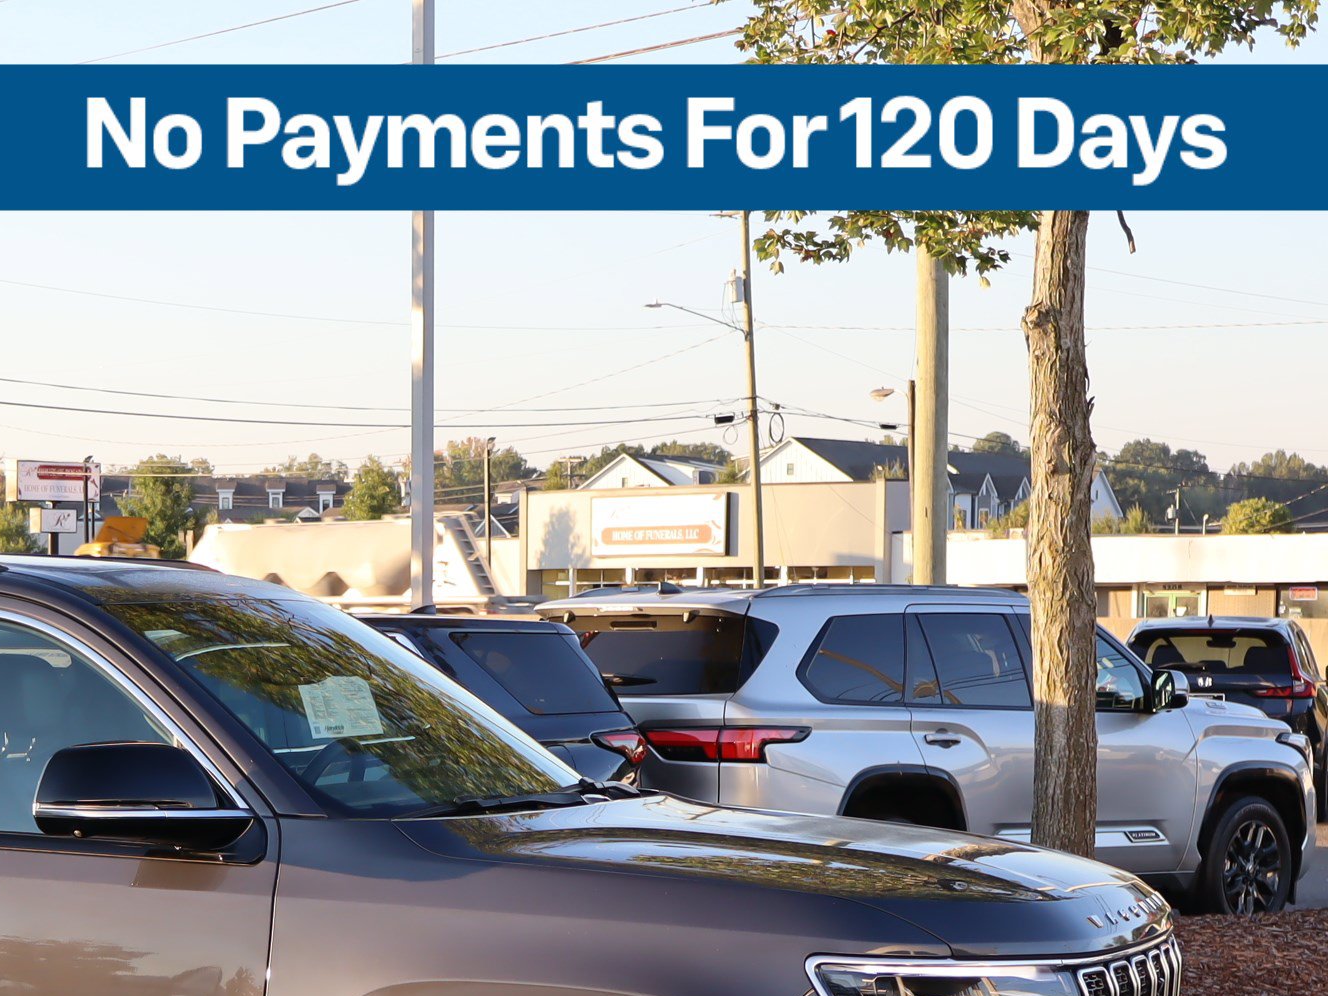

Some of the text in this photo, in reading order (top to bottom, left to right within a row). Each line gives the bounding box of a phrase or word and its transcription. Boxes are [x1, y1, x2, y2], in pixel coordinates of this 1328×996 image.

[612, 531, 633, 541] HOME
[634, 530, 645, 541] OF
[685, 528, 700, 540] LLC
